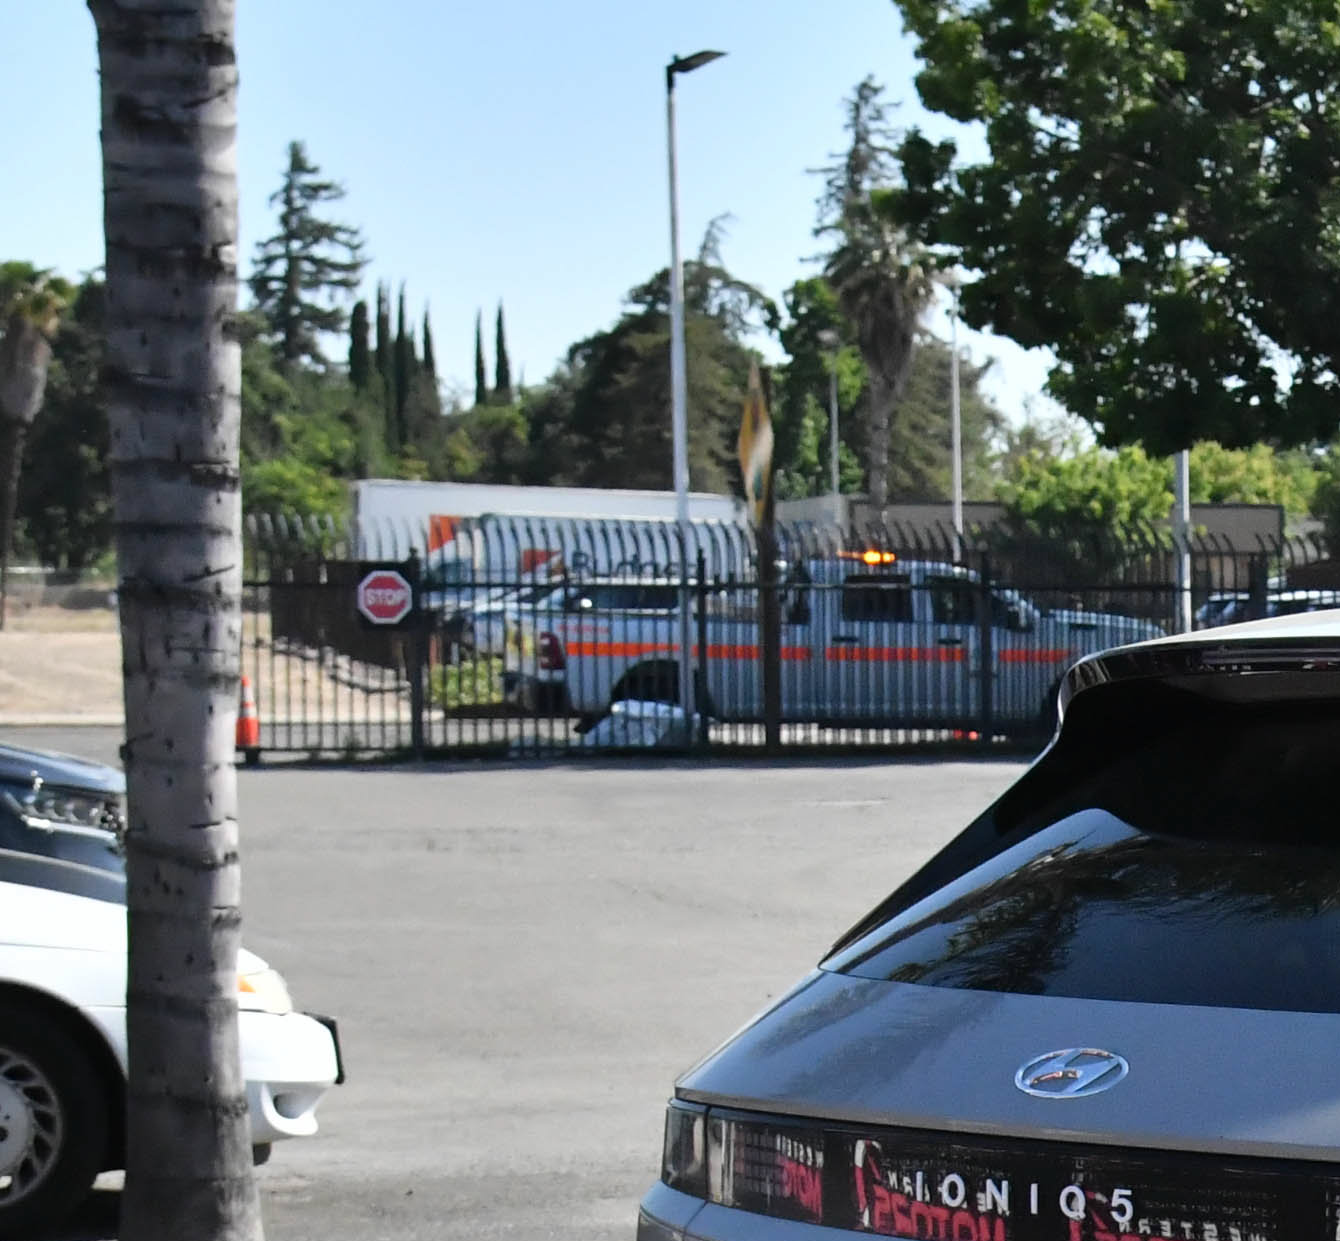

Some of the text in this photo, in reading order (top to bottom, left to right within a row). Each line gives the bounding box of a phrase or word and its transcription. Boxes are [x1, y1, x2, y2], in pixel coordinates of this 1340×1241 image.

[365, 589, 405, 606] STOP
[914, 1170, 1087, 1221] IONIQ
[1110, 1188, 1134, 1223] 5
